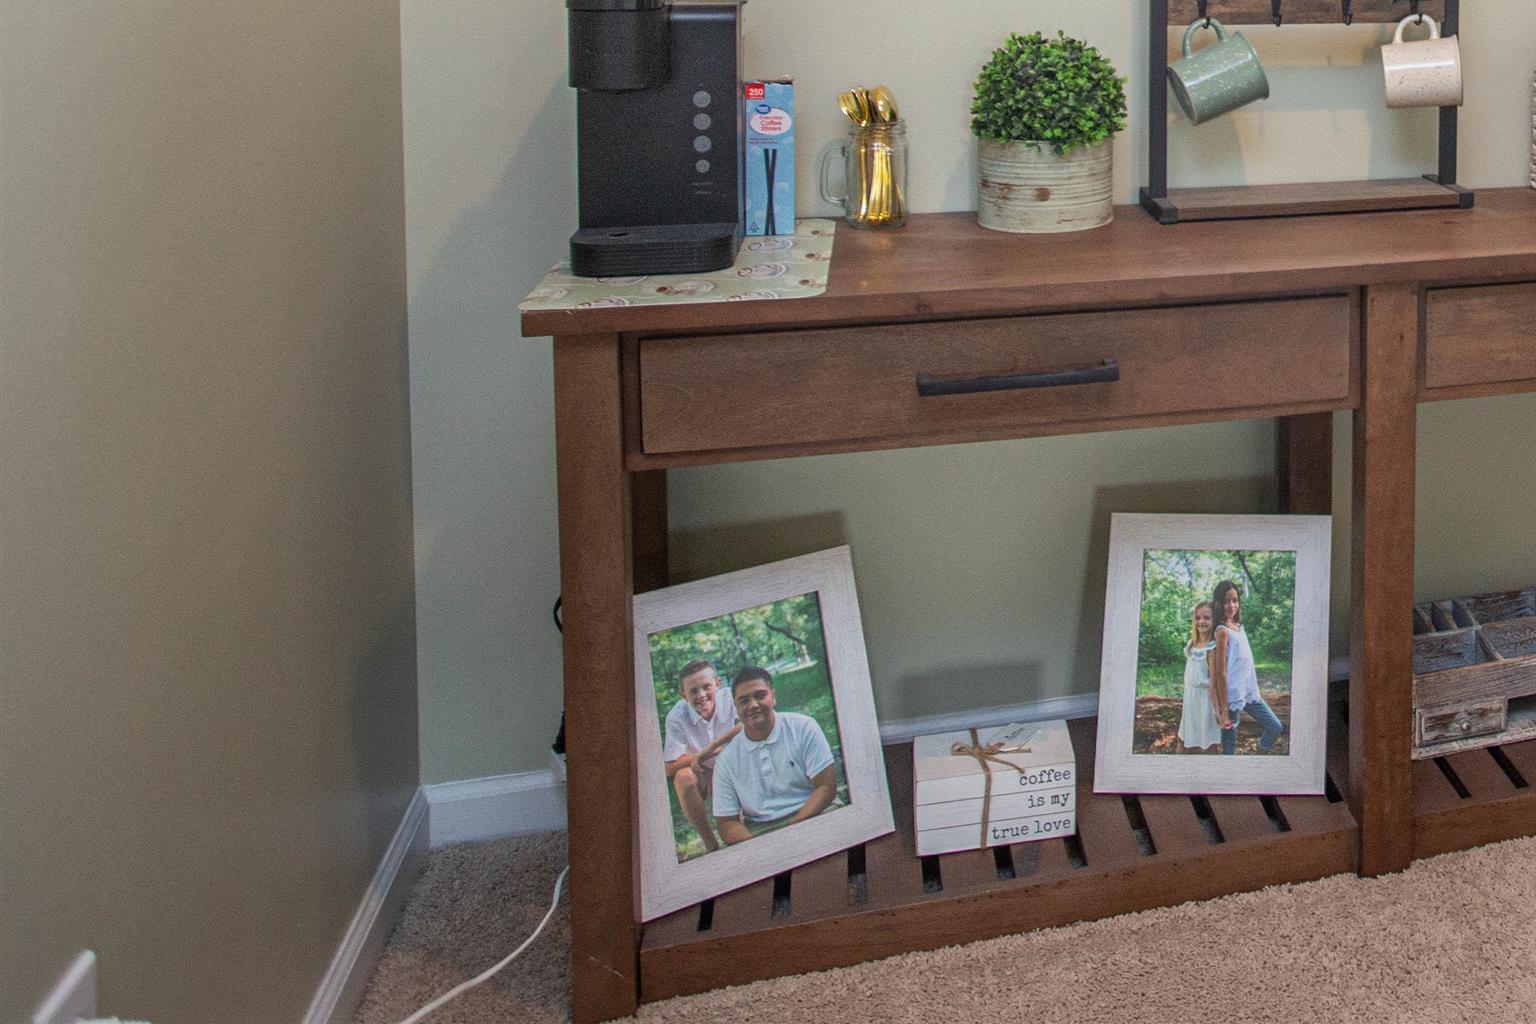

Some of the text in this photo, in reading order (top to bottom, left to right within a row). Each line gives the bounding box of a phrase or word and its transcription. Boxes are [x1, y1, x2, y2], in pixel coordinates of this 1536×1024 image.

[748, 88, 764, 96] 250
[1019, 769, 1071, 786] coffee
[1028, 793, 1070, 808] is my
[991, 819, 1071, 840] true love
